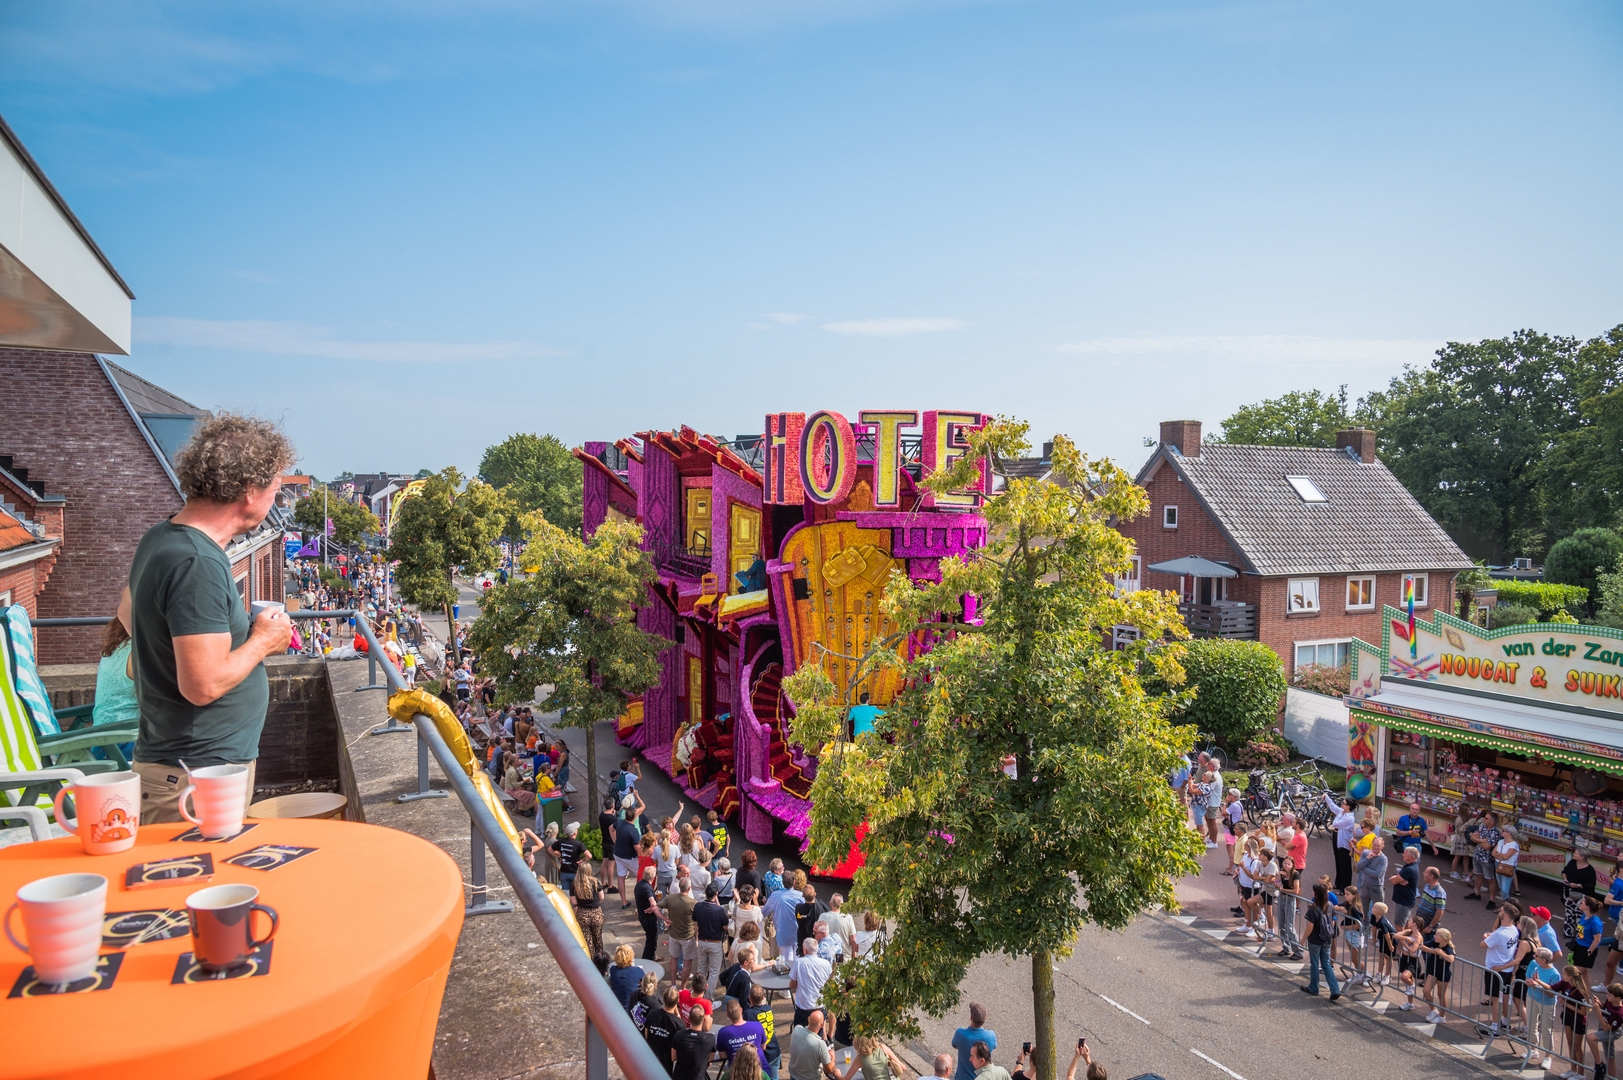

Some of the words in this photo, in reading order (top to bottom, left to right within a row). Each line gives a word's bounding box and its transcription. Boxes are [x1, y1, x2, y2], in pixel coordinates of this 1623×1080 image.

[1502, 641, 1535, 657] van
[1541, 637, 1576, 657] der
[1440, 652, 1520, 685] NOUGAT
[1530, 665, 1547, 689] &
[1564, 668, 1623, 701] SUIK
